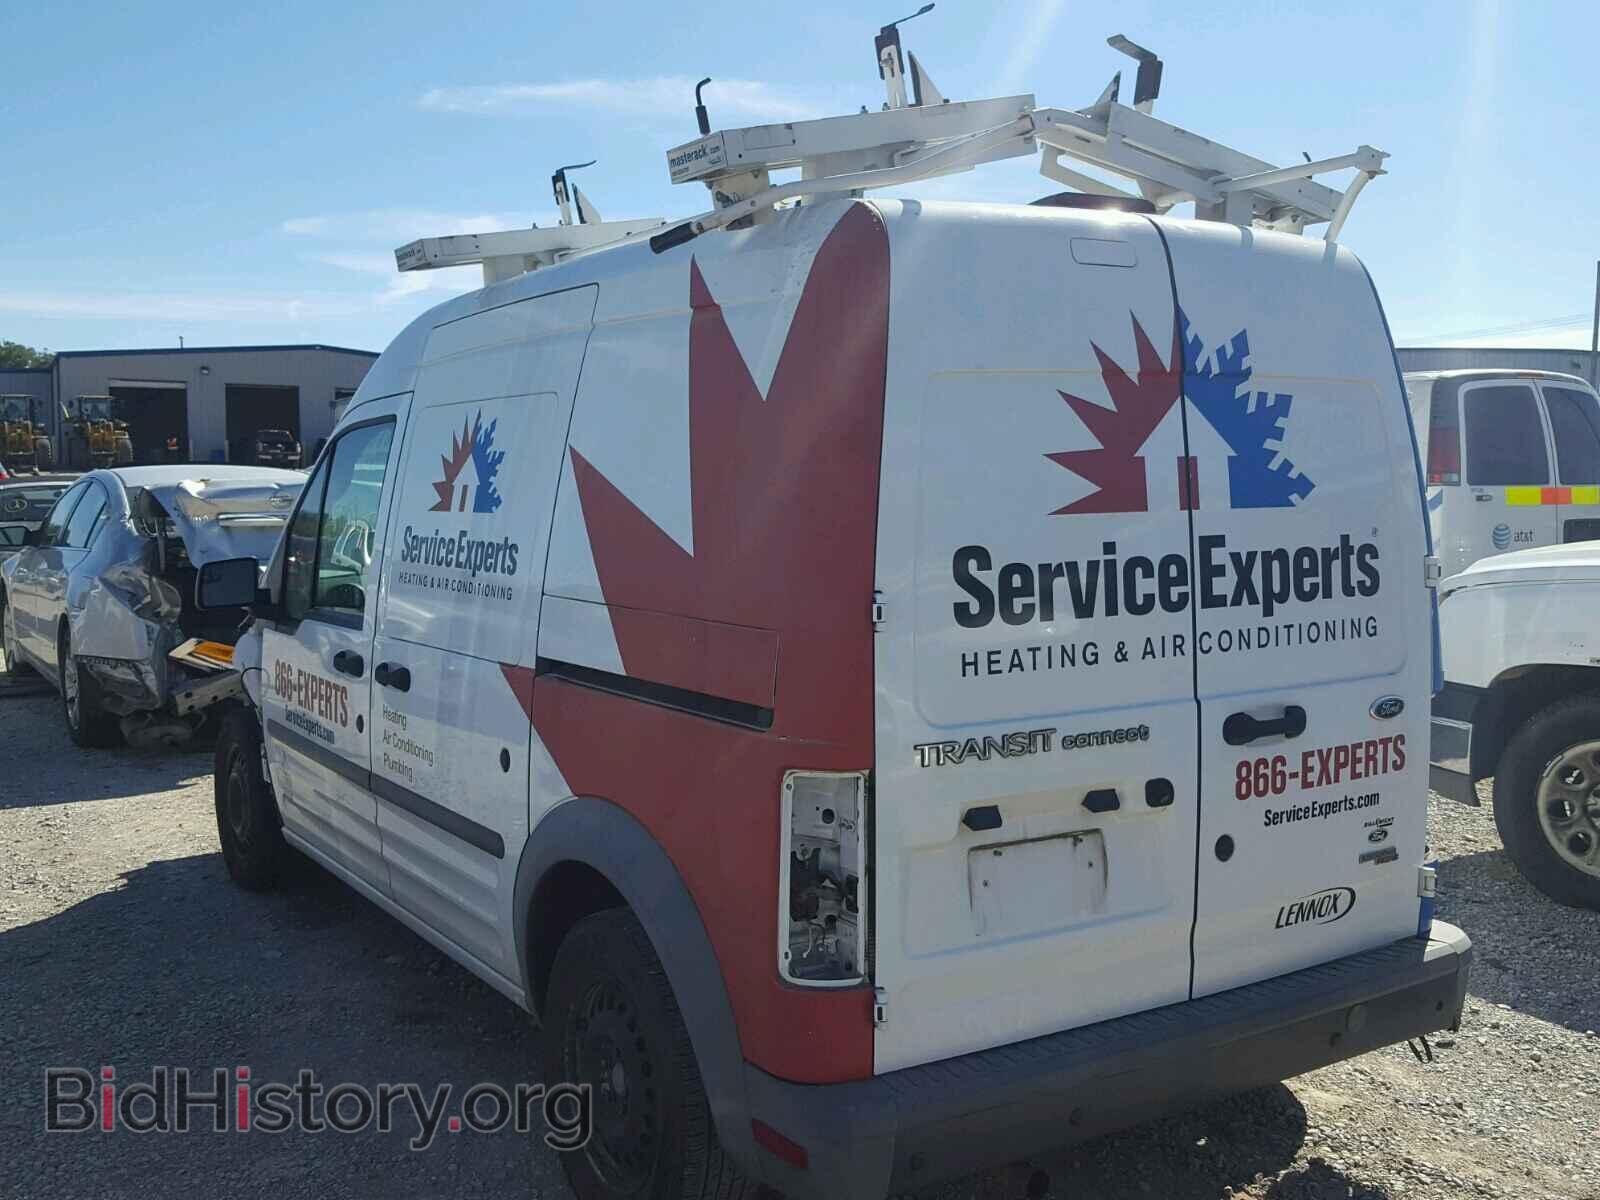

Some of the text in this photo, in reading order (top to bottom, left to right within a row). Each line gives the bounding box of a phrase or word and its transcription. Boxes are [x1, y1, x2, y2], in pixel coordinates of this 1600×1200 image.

[399, 571, 513, 601] HEATING & AIR CONDITIONING
[961, 615, 1378, 678] HEATING & AIR CONDITIONING
[275, 658, 349, 728] 866-EXPERTS
[383, 704, 407, 731] Heating
[383, 729, 433, 767] Air Conditioning
[913, 724, 1150, 768] TRANSIT connect
[1235, 734, 1405, 801] 866-EXPERTS
[1263, 792, 1380, 827] ServiceExperts.com
[1275, 892, 1343, 929] LENNOX
